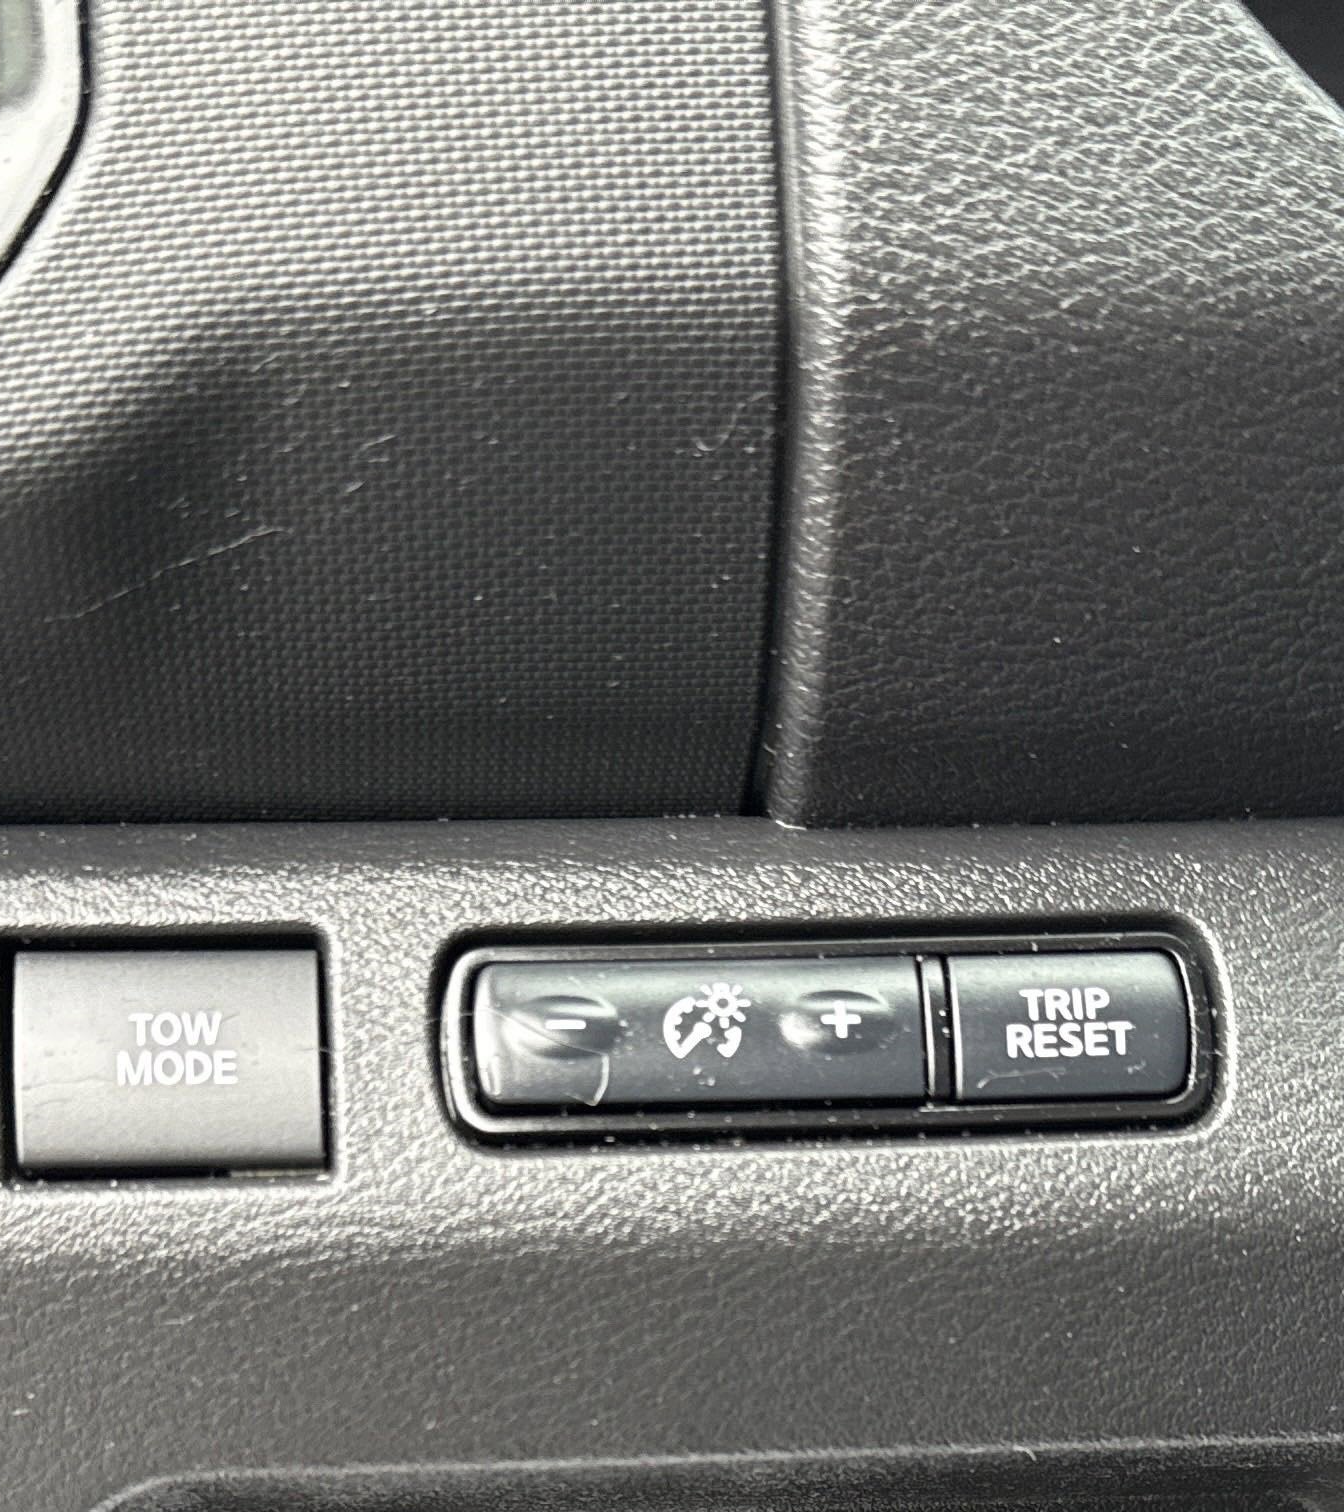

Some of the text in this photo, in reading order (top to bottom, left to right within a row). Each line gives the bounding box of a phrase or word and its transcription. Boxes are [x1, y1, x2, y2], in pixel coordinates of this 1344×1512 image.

[1018, 986, 1111, 1022] TRIP
[127, 1010, 223, 1047] TOW
[1006, 1020, 1135, 1058] RESET
[116, 1049, 239, 1086] MODE
